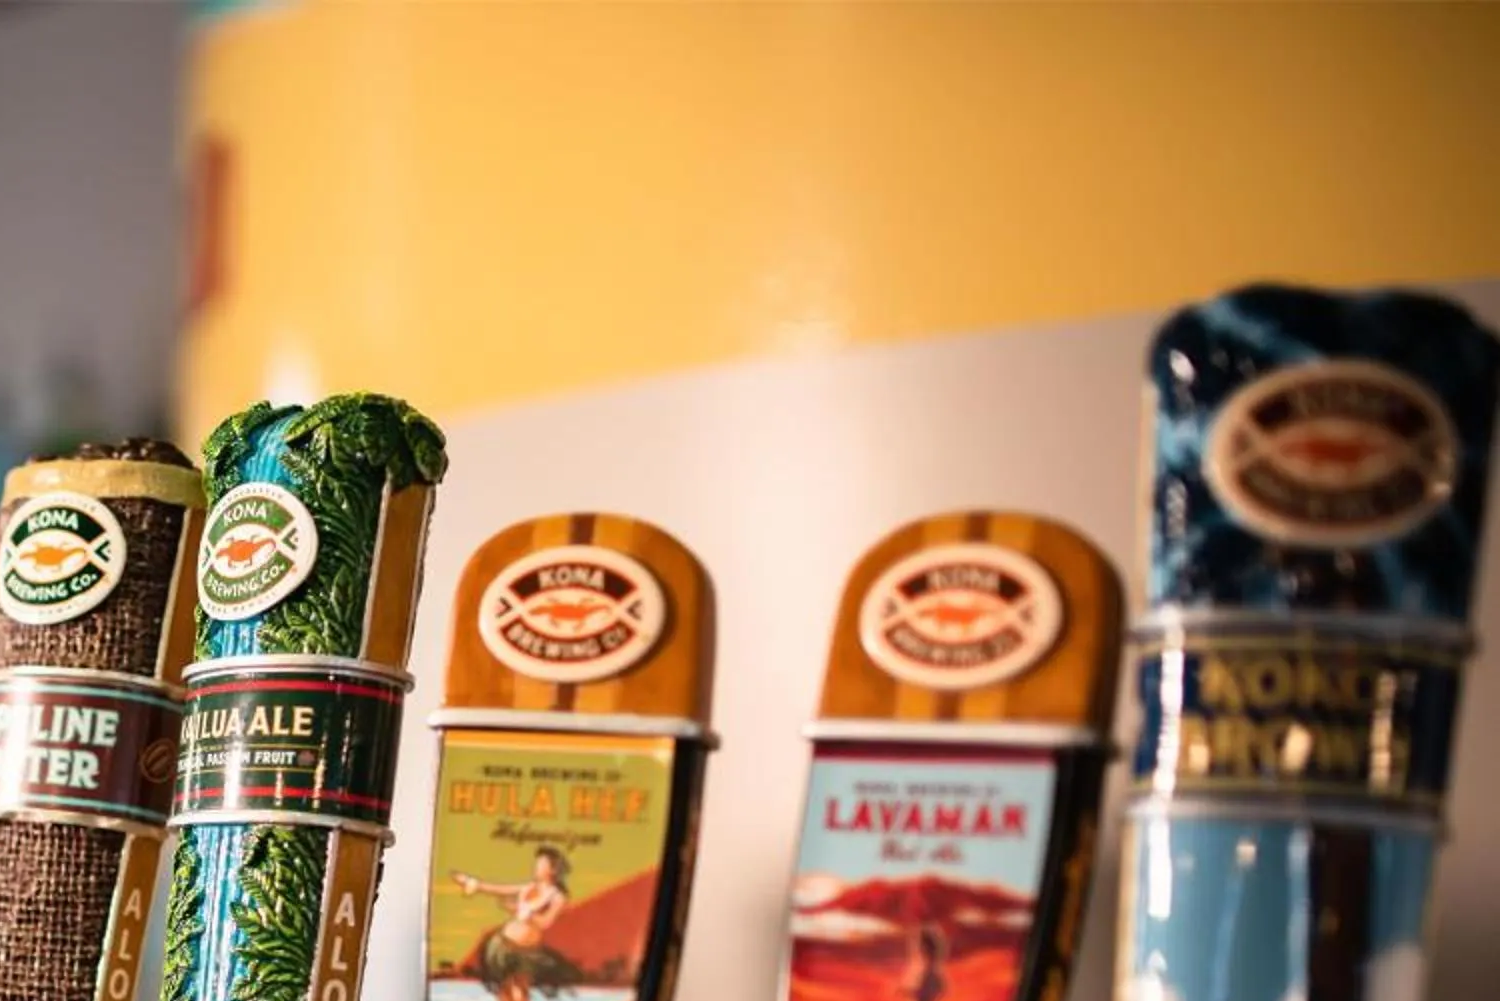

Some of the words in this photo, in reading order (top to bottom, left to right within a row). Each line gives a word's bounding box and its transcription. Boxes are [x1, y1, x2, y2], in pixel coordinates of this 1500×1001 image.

[27, 509, 79, 533] KONA
[223, 502, 267, 526] KONA
[6, 573, 68, 600] BREWING
[538, 565, 605, 591] KONA
[506, 622, 601, 659] BREWING
[247, 706, 314, 737] ALE
[206, 751, 250, 767] PASSN
[254, 750, 296, 765] FRUIT
[449, 779, 558, 819] HULA
[824, 796, 1027, 838] LAVAMAN
